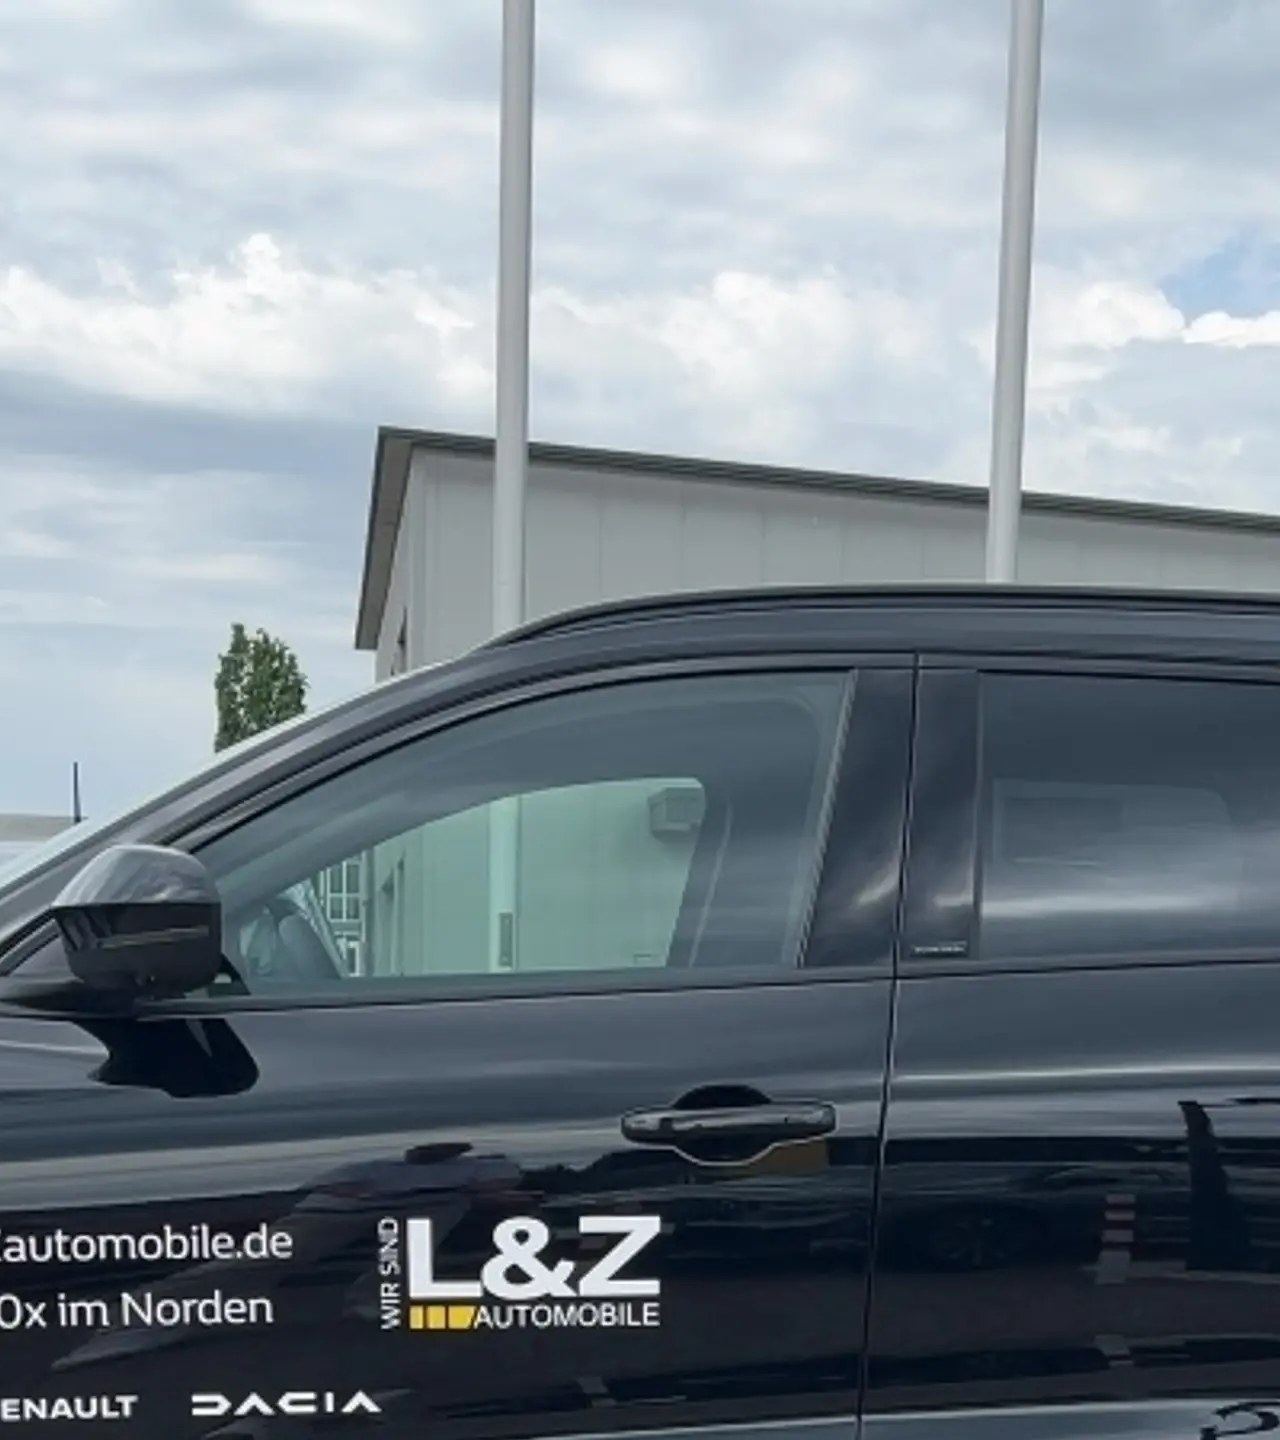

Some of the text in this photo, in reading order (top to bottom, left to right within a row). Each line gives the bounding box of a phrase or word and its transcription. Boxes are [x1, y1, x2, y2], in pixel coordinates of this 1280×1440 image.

[377, 1217, 402, 1330] WIR SIND
[406, 1216, 661, 1301] L&Z
[57, 1292, 111, 1328] im
[120, 1289, 275, 1328] Norden
[473, 1302, 661, 1330] AUTOMOBILE
[190, 1390, 383, 1417] DACIA
